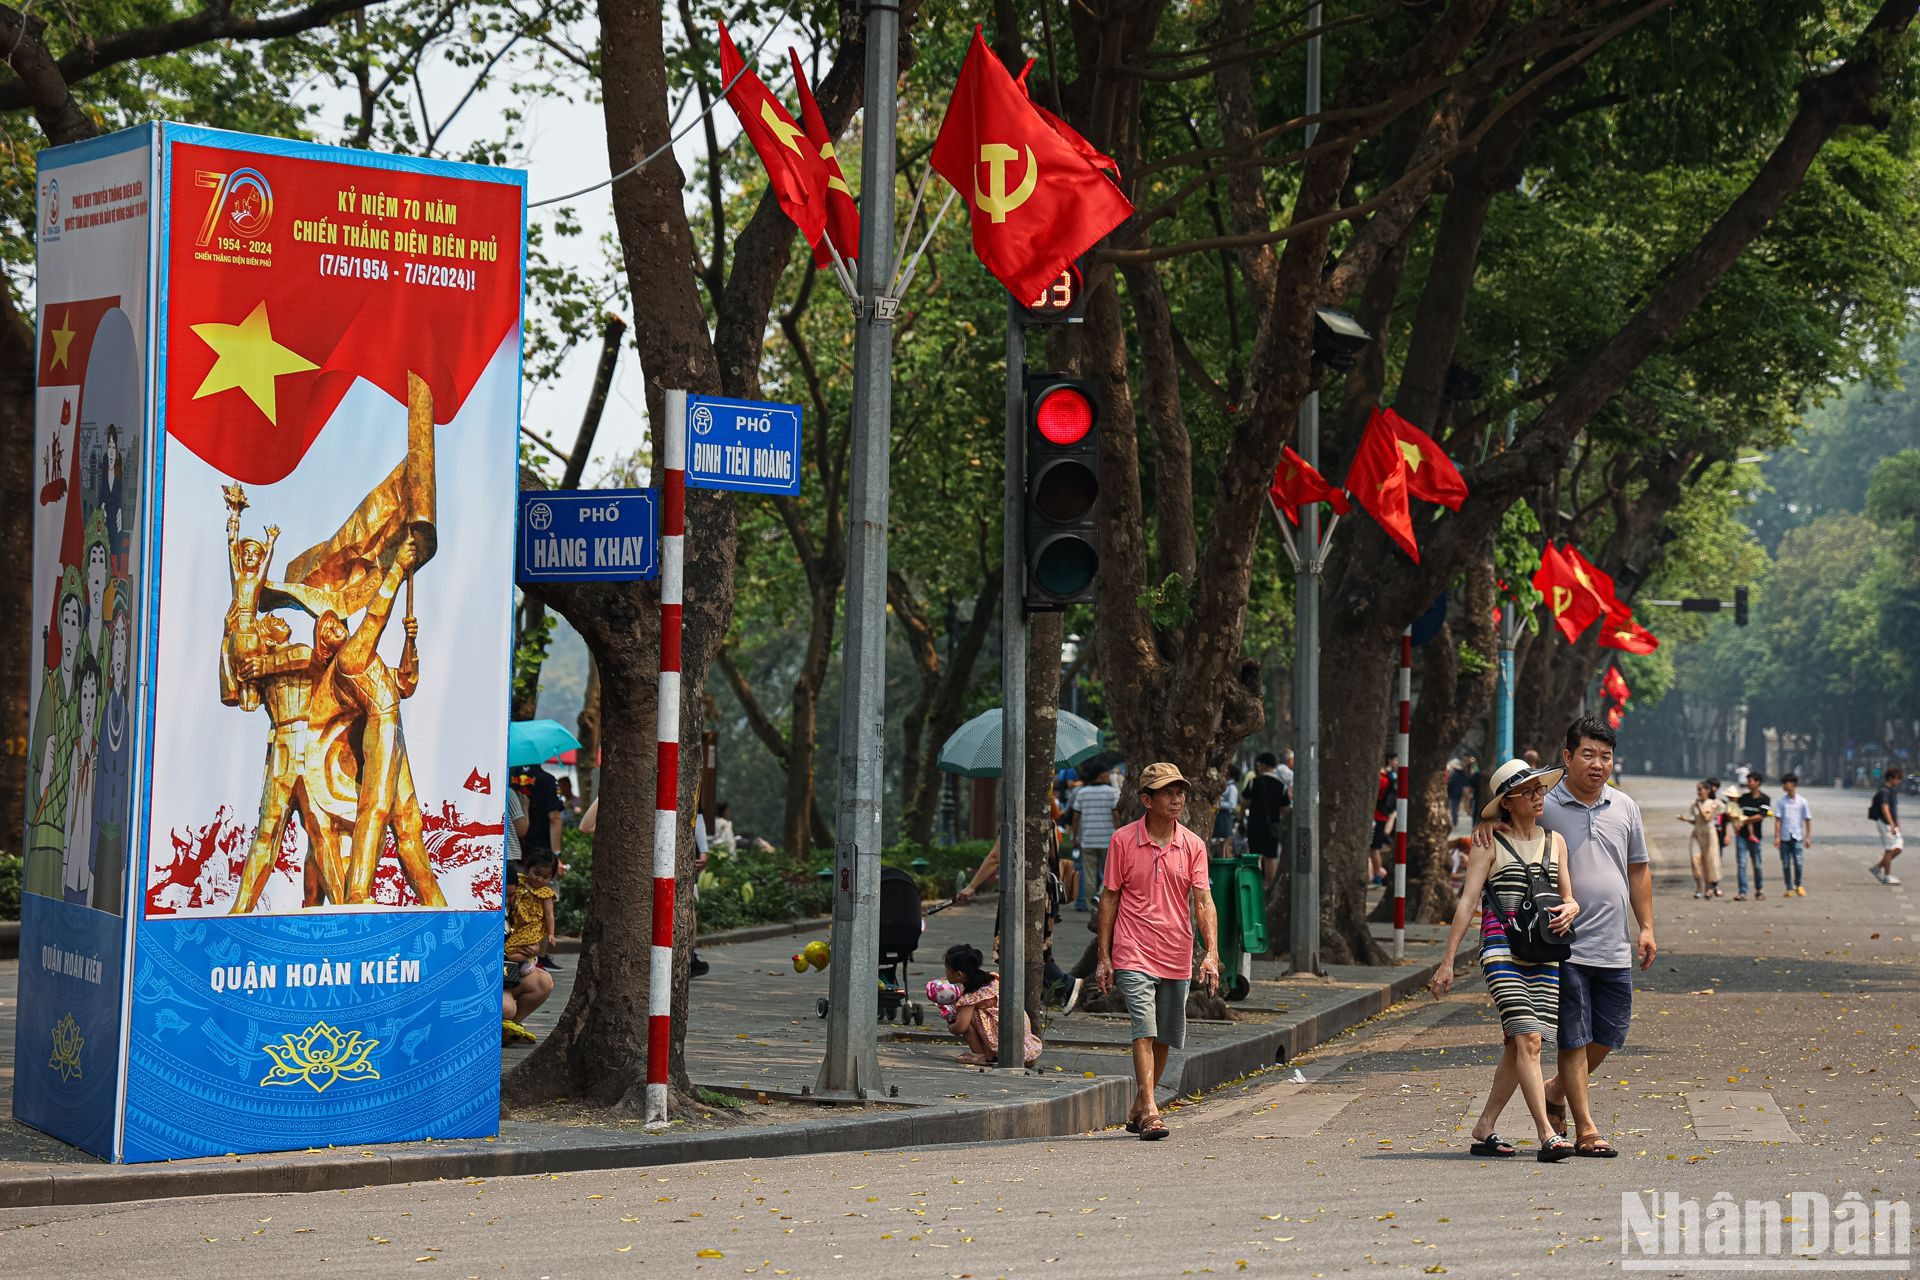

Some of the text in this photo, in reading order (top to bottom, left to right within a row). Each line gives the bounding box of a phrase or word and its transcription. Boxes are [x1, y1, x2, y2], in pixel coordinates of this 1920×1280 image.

[195, 167, 274, 247] 70
[338, 185, 457, 225] KỶ NIỆM 70 NĂM
[218, 236, 241, 251] 1954
[249, 240, 273, 254] 2024
[293, 216, 498, 262] CHIẾN THẮNG ĐIỆN BIÊN PHỦ
[194, 251, 272, 267] CHIẾN THẮNG ĐIỆN BIÊN PHỦ
[319, 253, 389, 281] (7/5/1954
[404, 262, 476, 291] 7/5/2024)!
[735, 411, 773, 434] PHỐ
[693, 440, 791, 480] ĐINH TIÊN HOÀNG
[579, 500, 620, 523] PHỐ
[534, 532, 644, 568] HÀNG KHAY
[42, 943, 103, 985] QUẬN HOÀN KIẾM
[210, 952, 421, 996] QUẬN HOÀN KIẾM
